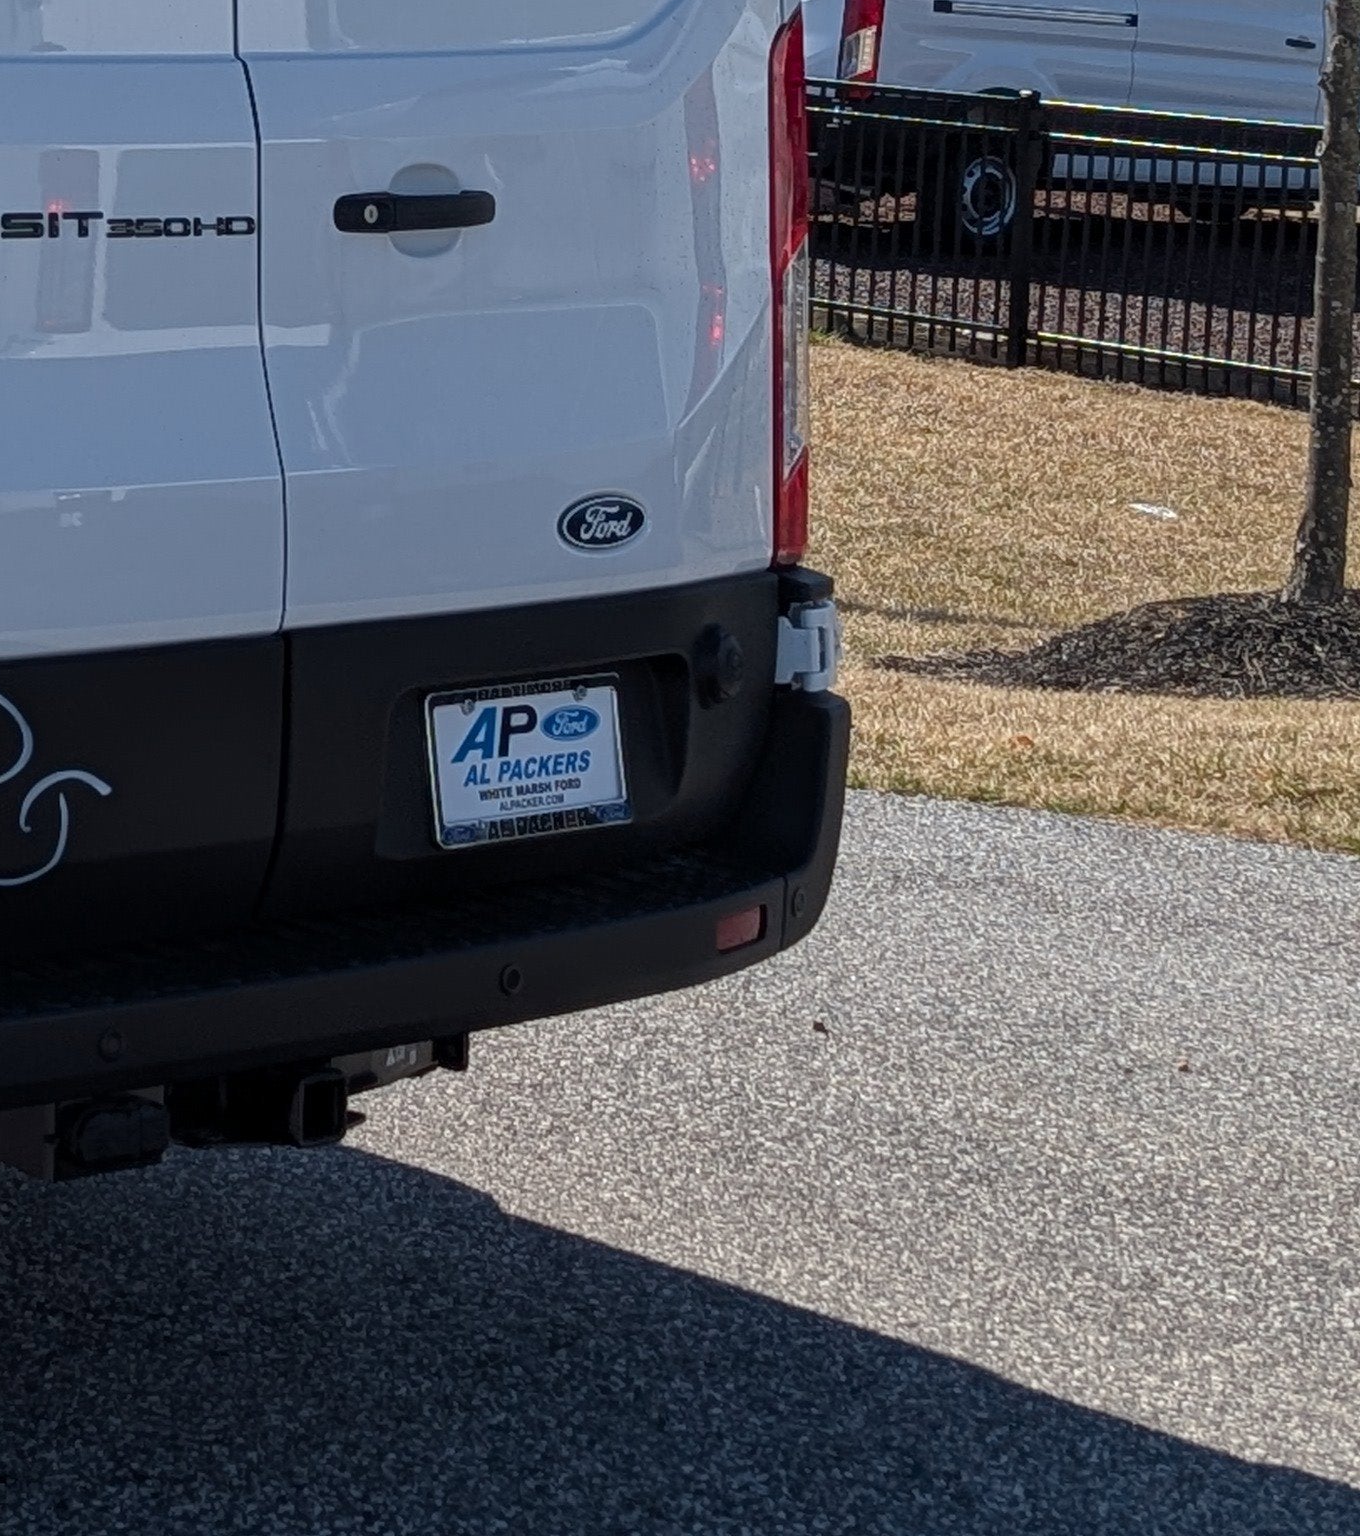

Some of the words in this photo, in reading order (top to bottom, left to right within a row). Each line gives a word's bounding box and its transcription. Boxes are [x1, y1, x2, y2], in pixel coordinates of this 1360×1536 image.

[106, 216, 256, 239] 350HD
[580, 505, 633, 540] Ford
[451, 704, 538, 763] AP
[551, 711, 591, 736] Ford
[464, 764, 491, 787] AL
[498, 750, 591, 783] PACKERS
[479, 786, 513, 801] WHITE
[516, 782, 552, 797] MARSH
[554, 778, 581, 792] FORD
